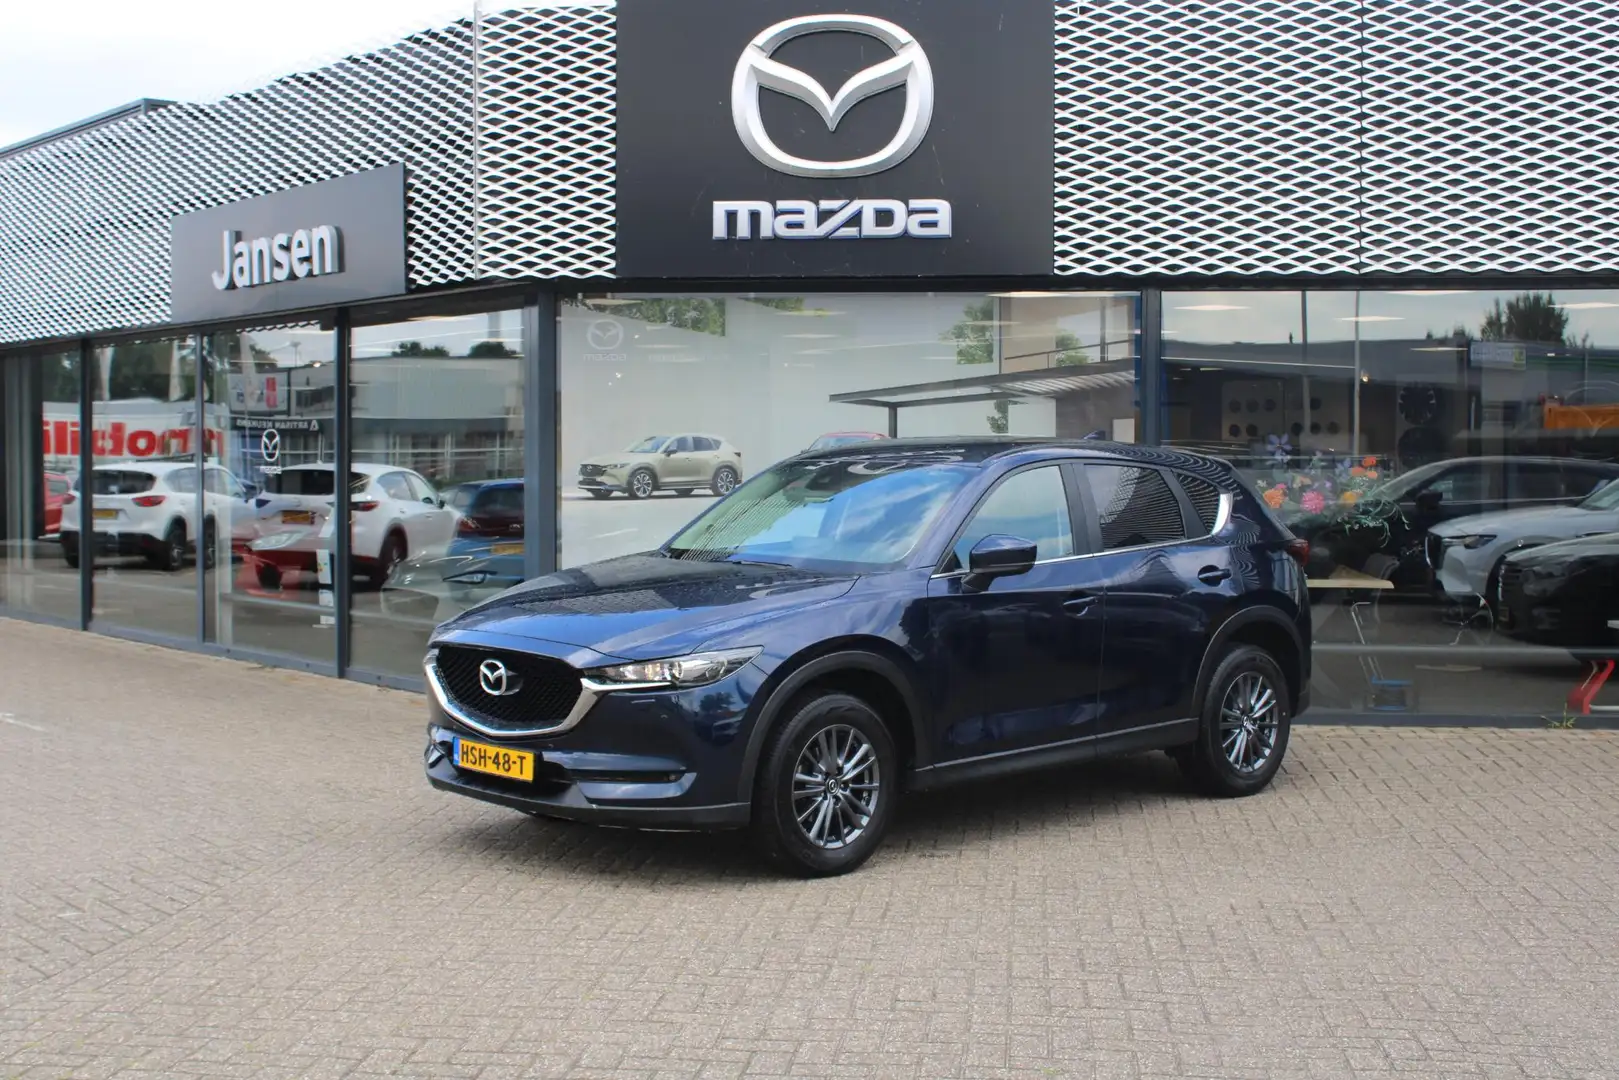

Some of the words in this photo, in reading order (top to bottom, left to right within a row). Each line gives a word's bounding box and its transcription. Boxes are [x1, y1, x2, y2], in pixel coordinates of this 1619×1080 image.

[712, 199, 952, 240] mazda
[211, 225, 338, 290] Jansen
[461, 743, 526, 775] HSH-48-T
